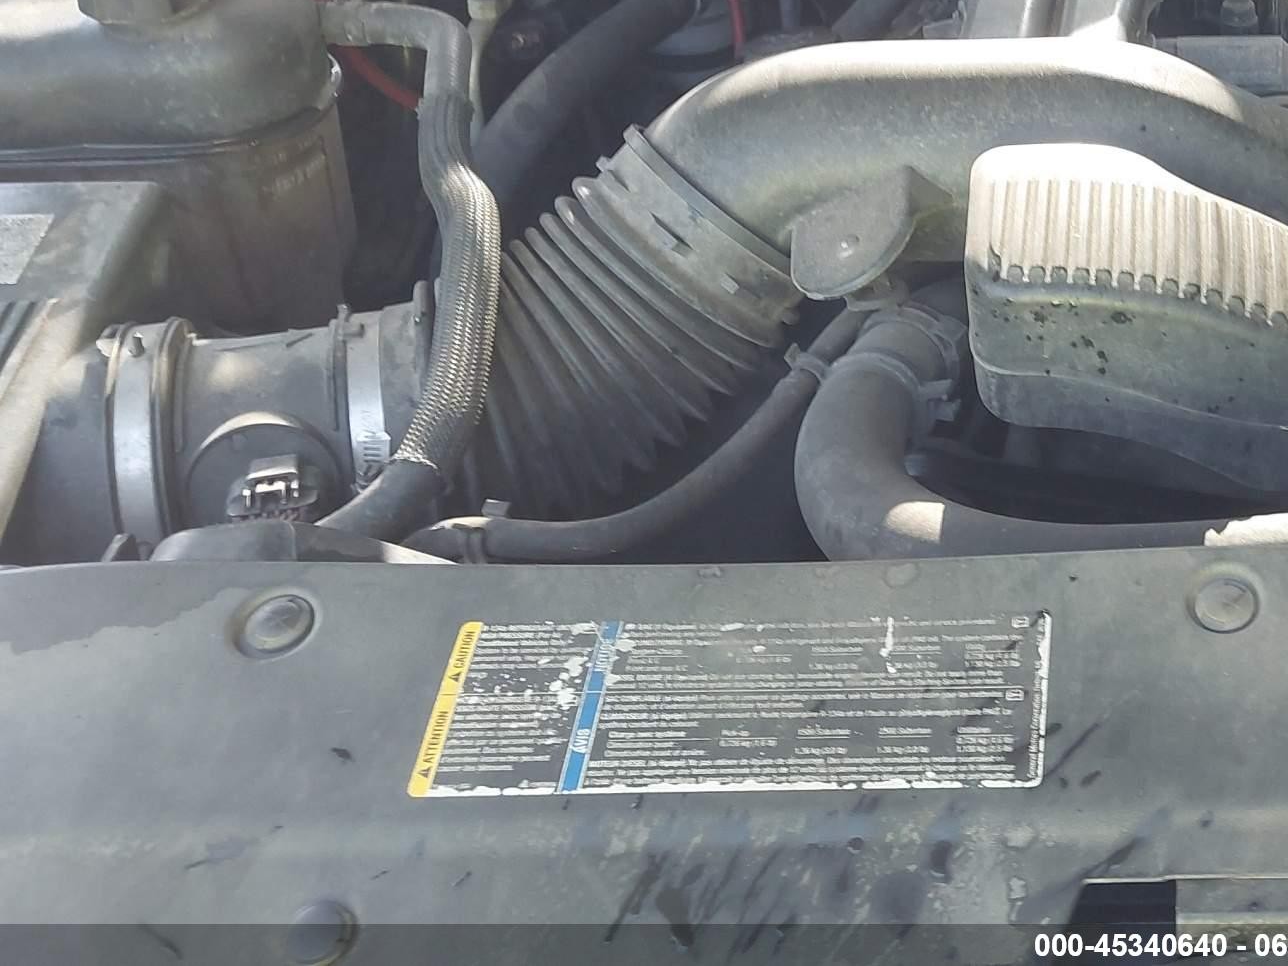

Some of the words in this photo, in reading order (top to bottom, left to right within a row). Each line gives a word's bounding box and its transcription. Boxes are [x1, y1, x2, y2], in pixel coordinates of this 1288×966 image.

[454, 630, 475, 669] CAUTION
[422, 710, 449, 765] ATTENTION
[570, 728, 590, 754] AVIS
